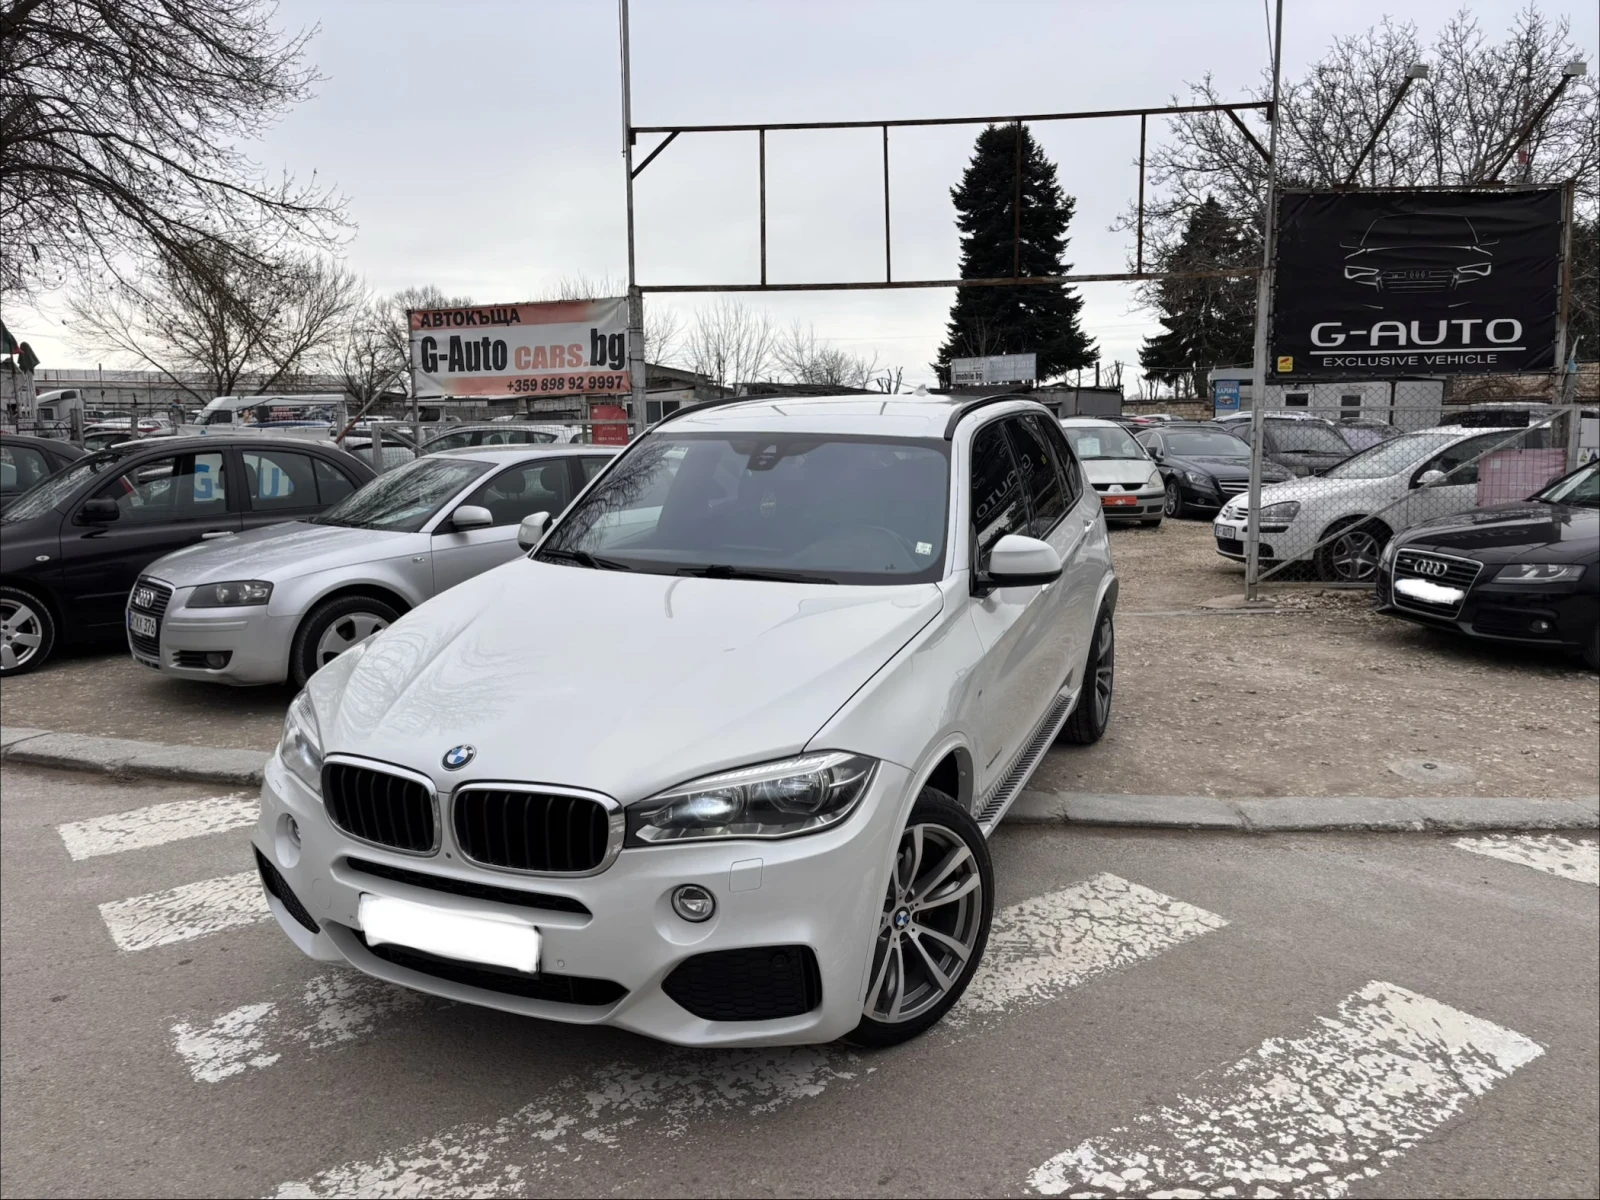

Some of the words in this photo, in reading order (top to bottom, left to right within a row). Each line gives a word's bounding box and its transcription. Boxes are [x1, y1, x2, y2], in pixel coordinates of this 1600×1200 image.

[421, 308, 521, 327] АВТОКЪЩА
[1310, 318, 1523, 347] G-AUTO
[421, 335, 507, 373] G-Auto
[1323, 356, 1418, 367] EXCLUSIVE
[1424, 354, 1498, 366] VEHICLE
[507, 378, 537, 392] +359
[540, 377, 565, 392] 898
[568, 377, 584, 390] 92
[588, 375, 623, 390] 9997
